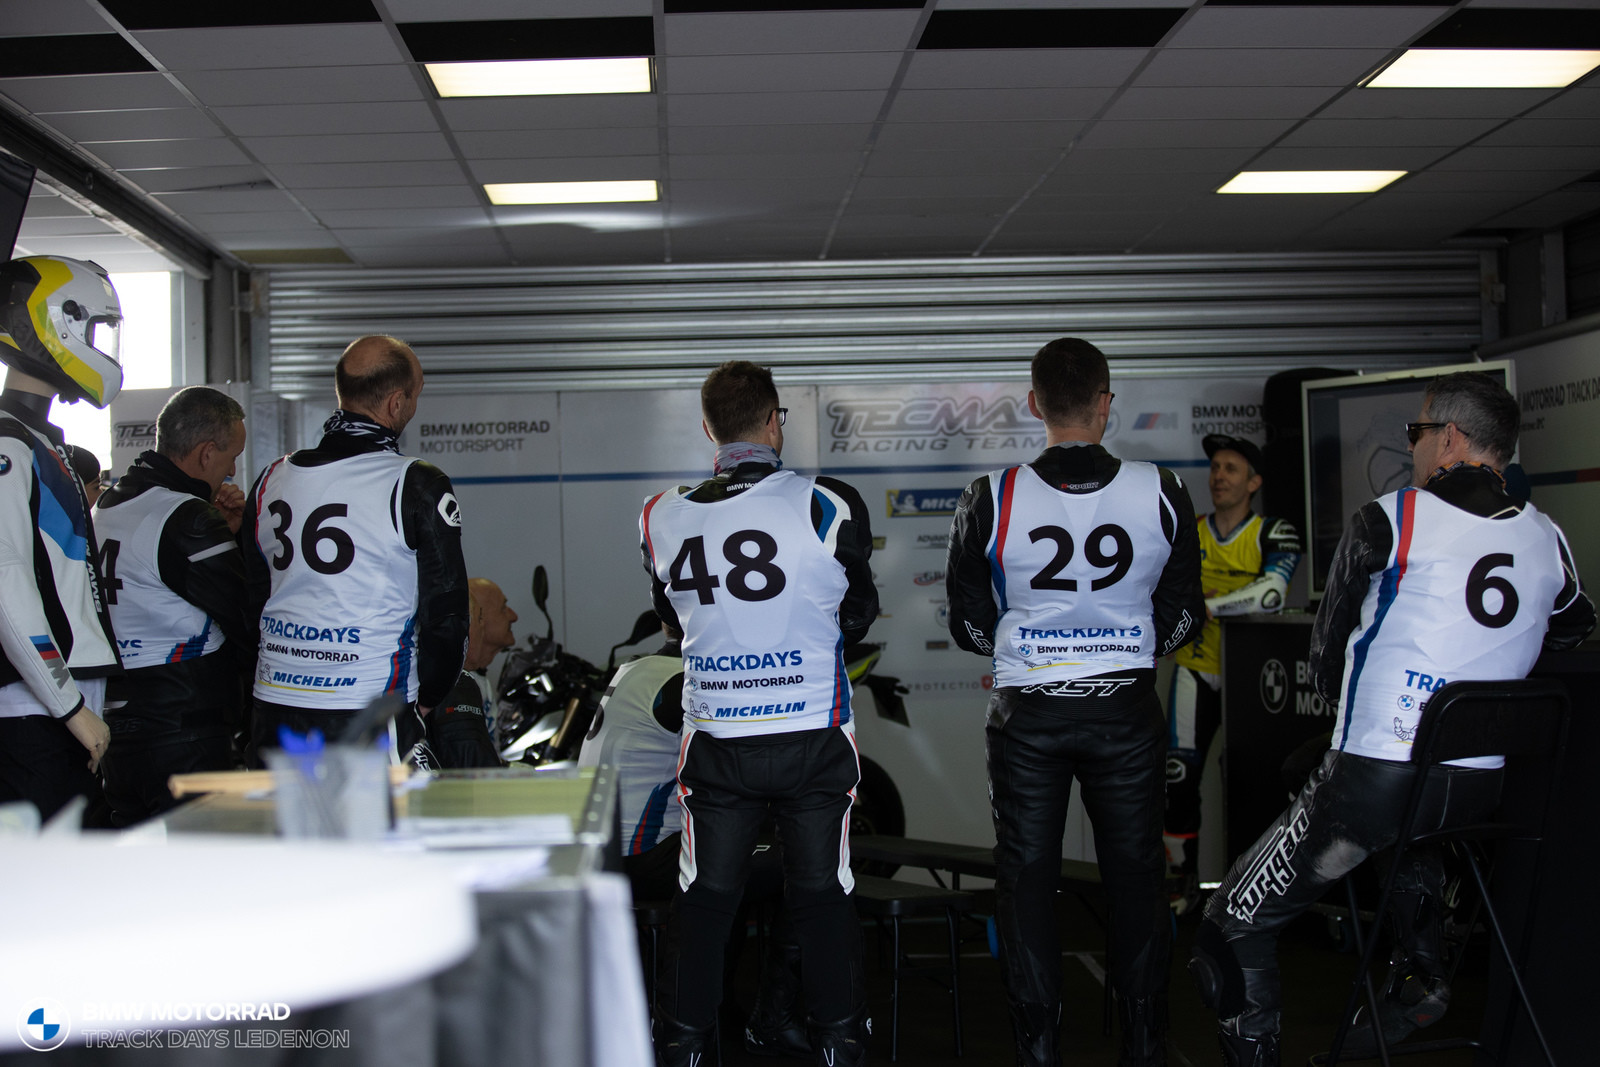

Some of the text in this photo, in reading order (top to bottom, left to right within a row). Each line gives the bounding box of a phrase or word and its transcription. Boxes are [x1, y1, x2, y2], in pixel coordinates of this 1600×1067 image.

[1566, 379, 1592, 404] TRACK
[827, 396, 1046, 438] TECMA
[1192, 405, 1229, 419] BMW
[420, 420, 550, 437] BMW MOTORRAD
[420, 438, 525, 454] MOTORSPORT
[830, 436, 1047, 453] RACING TEAM
[726, 482, 744, 492] BMW
[268, 499, 355, 575] 36
[1028, 523, 1134, 592] 29
[669, 529, 786, 605] 48
[1465, 552, 1519, 629] 6
[262, 616, 360, 643] TRACKDAYS
[1018, 625, 1142, 639] TRACKDAYS
[266, 643, 359, 662] BMW MOTORRAD
[1037, 644, 1140, 653] BMW MOTORRAD
[687, 650, 803, 671] TRACKDAYS
[273, 671, 357, 687] MICHELIN
[700, 675, 804, 690] BMW MOTORRAD
[715, 701, 806, 717] MICHELIN
